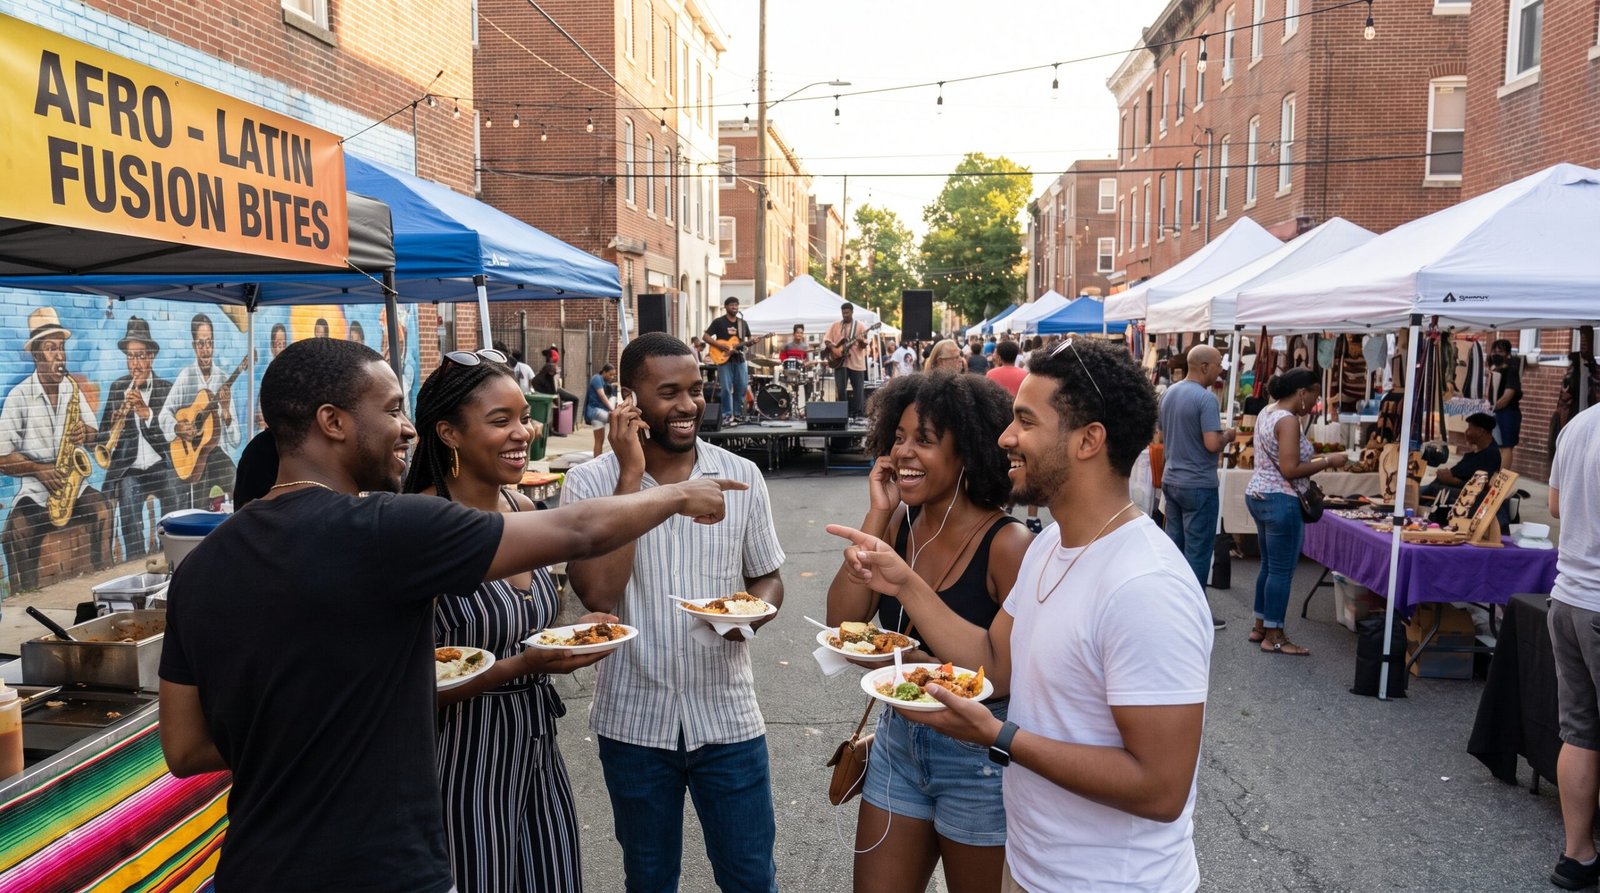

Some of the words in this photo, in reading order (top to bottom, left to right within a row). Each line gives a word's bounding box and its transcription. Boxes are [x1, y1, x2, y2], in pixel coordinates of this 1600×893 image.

[34, 49, 173, 149] AFRO
[187, 125, 204, 141] -
[216, 108, 314, 187] LATIN
[47, 136, 226, 232] FUSION
[238, 182, 330, 250] BITES
